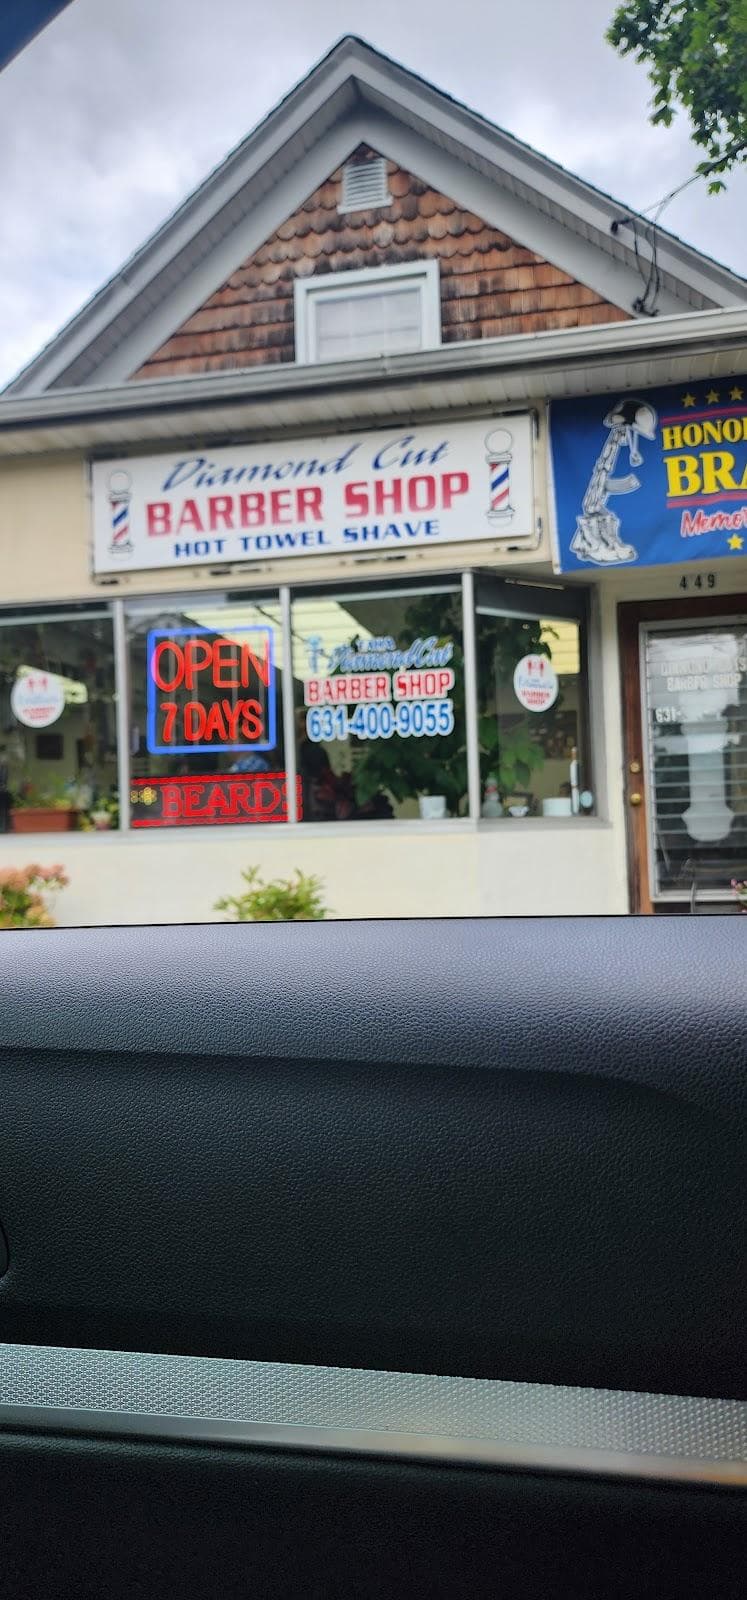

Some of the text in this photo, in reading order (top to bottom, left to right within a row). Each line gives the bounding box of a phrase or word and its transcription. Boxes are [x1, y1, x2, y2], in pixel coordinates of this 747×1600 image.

[662, 416, 747, 450] HONO
[162, 435, 451, 492] Diamond Cut
[146, 472, 470, 538] BARBER SHOP
[174, 519, 440, 558] HOT TOWEL SHAVE
[151, 639, 271, 692] OPEN
[307, 672, 451, 702] BARBER SHOP
[160, 699, 264, 742] 7 DAYS
[308, 703, 452, 738] 631-400-9055
